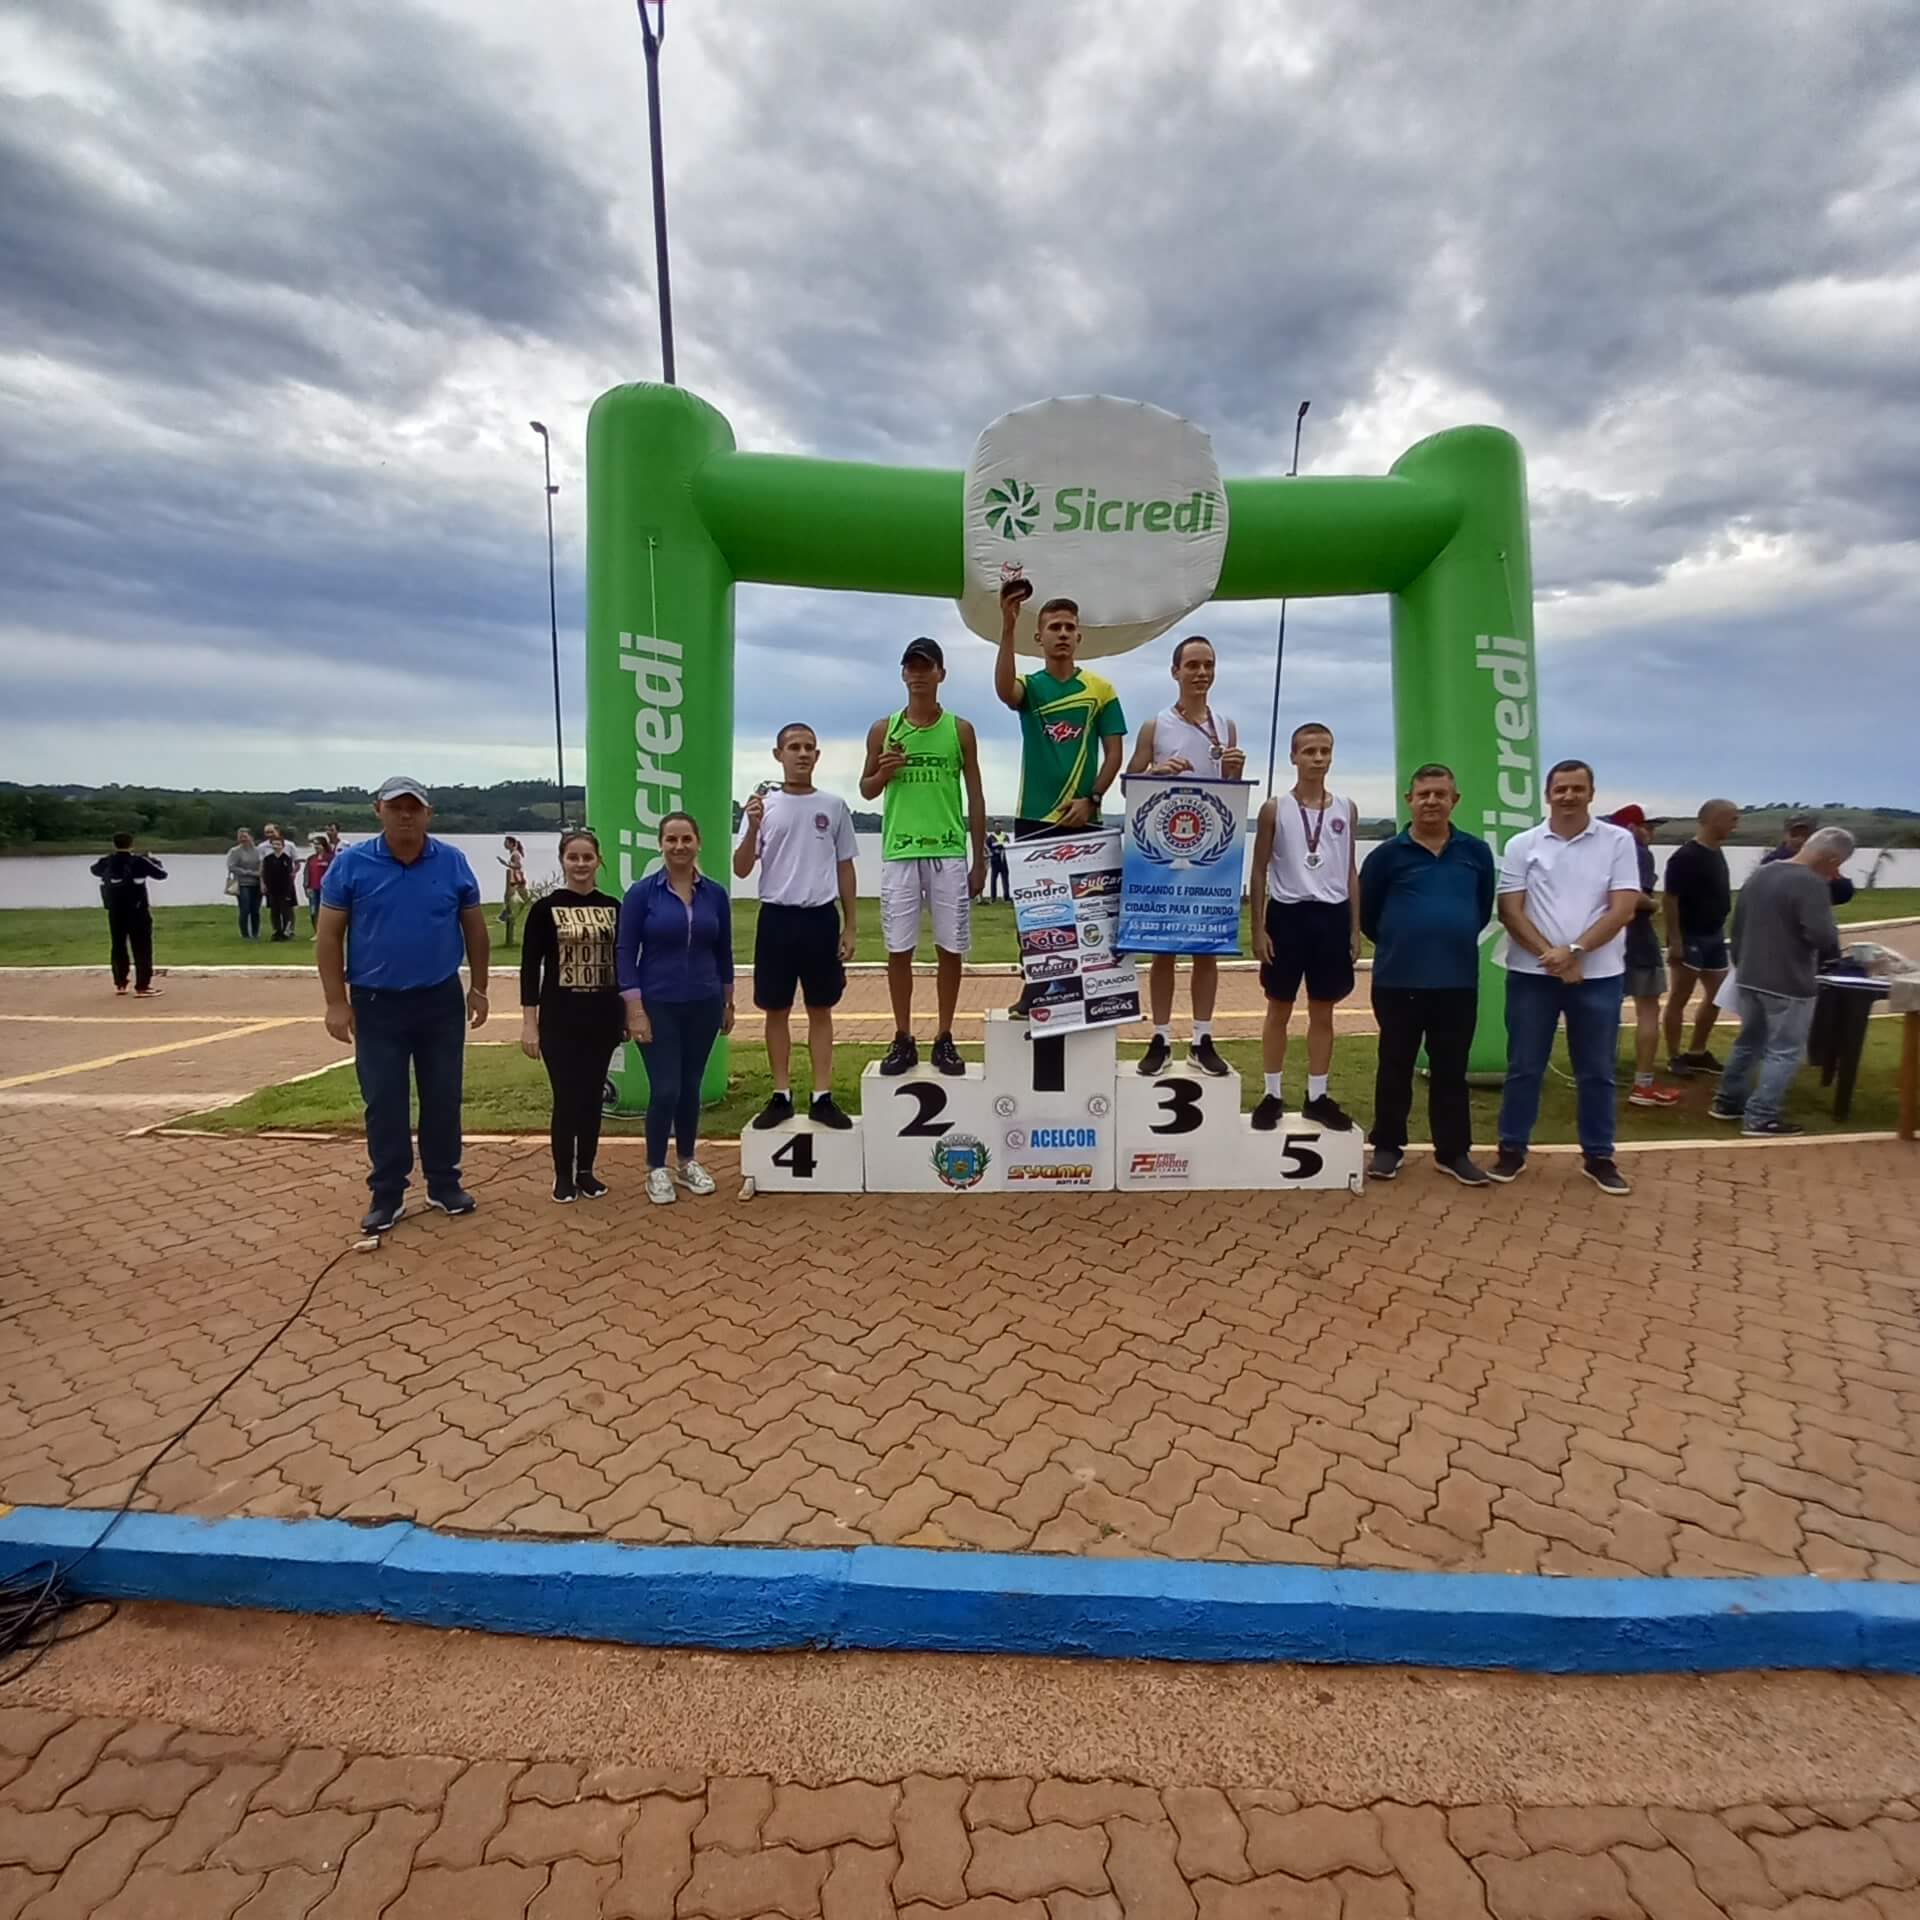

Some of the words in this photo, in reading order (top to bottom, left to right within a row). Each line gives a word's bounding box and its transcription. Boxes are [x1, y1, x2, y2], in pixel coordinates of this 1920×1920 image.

[1053, 487, 1216, 533] Sicredi
[1013, 885, 1068, 900] Sandro
[1129, 884, 1174, 896] EDUCANDO
[1177, 886, 1182, 896] E
[1184, 886, 1232, 897] FORMANDO
[1169, 903, 1191, 914] PARA
[1193, 905, 1199, 914] O
[1201, 905, 1234, 916] MUNDO
[894, 1081, 956, 1137] 2
[1149, 1078, 1204, 1135] 3
[771, 1132, 817, 1178] 4
[1031, 1129, 1096, 1148] ACELCOR
[1280, 1134, 1323, 1180] 5
